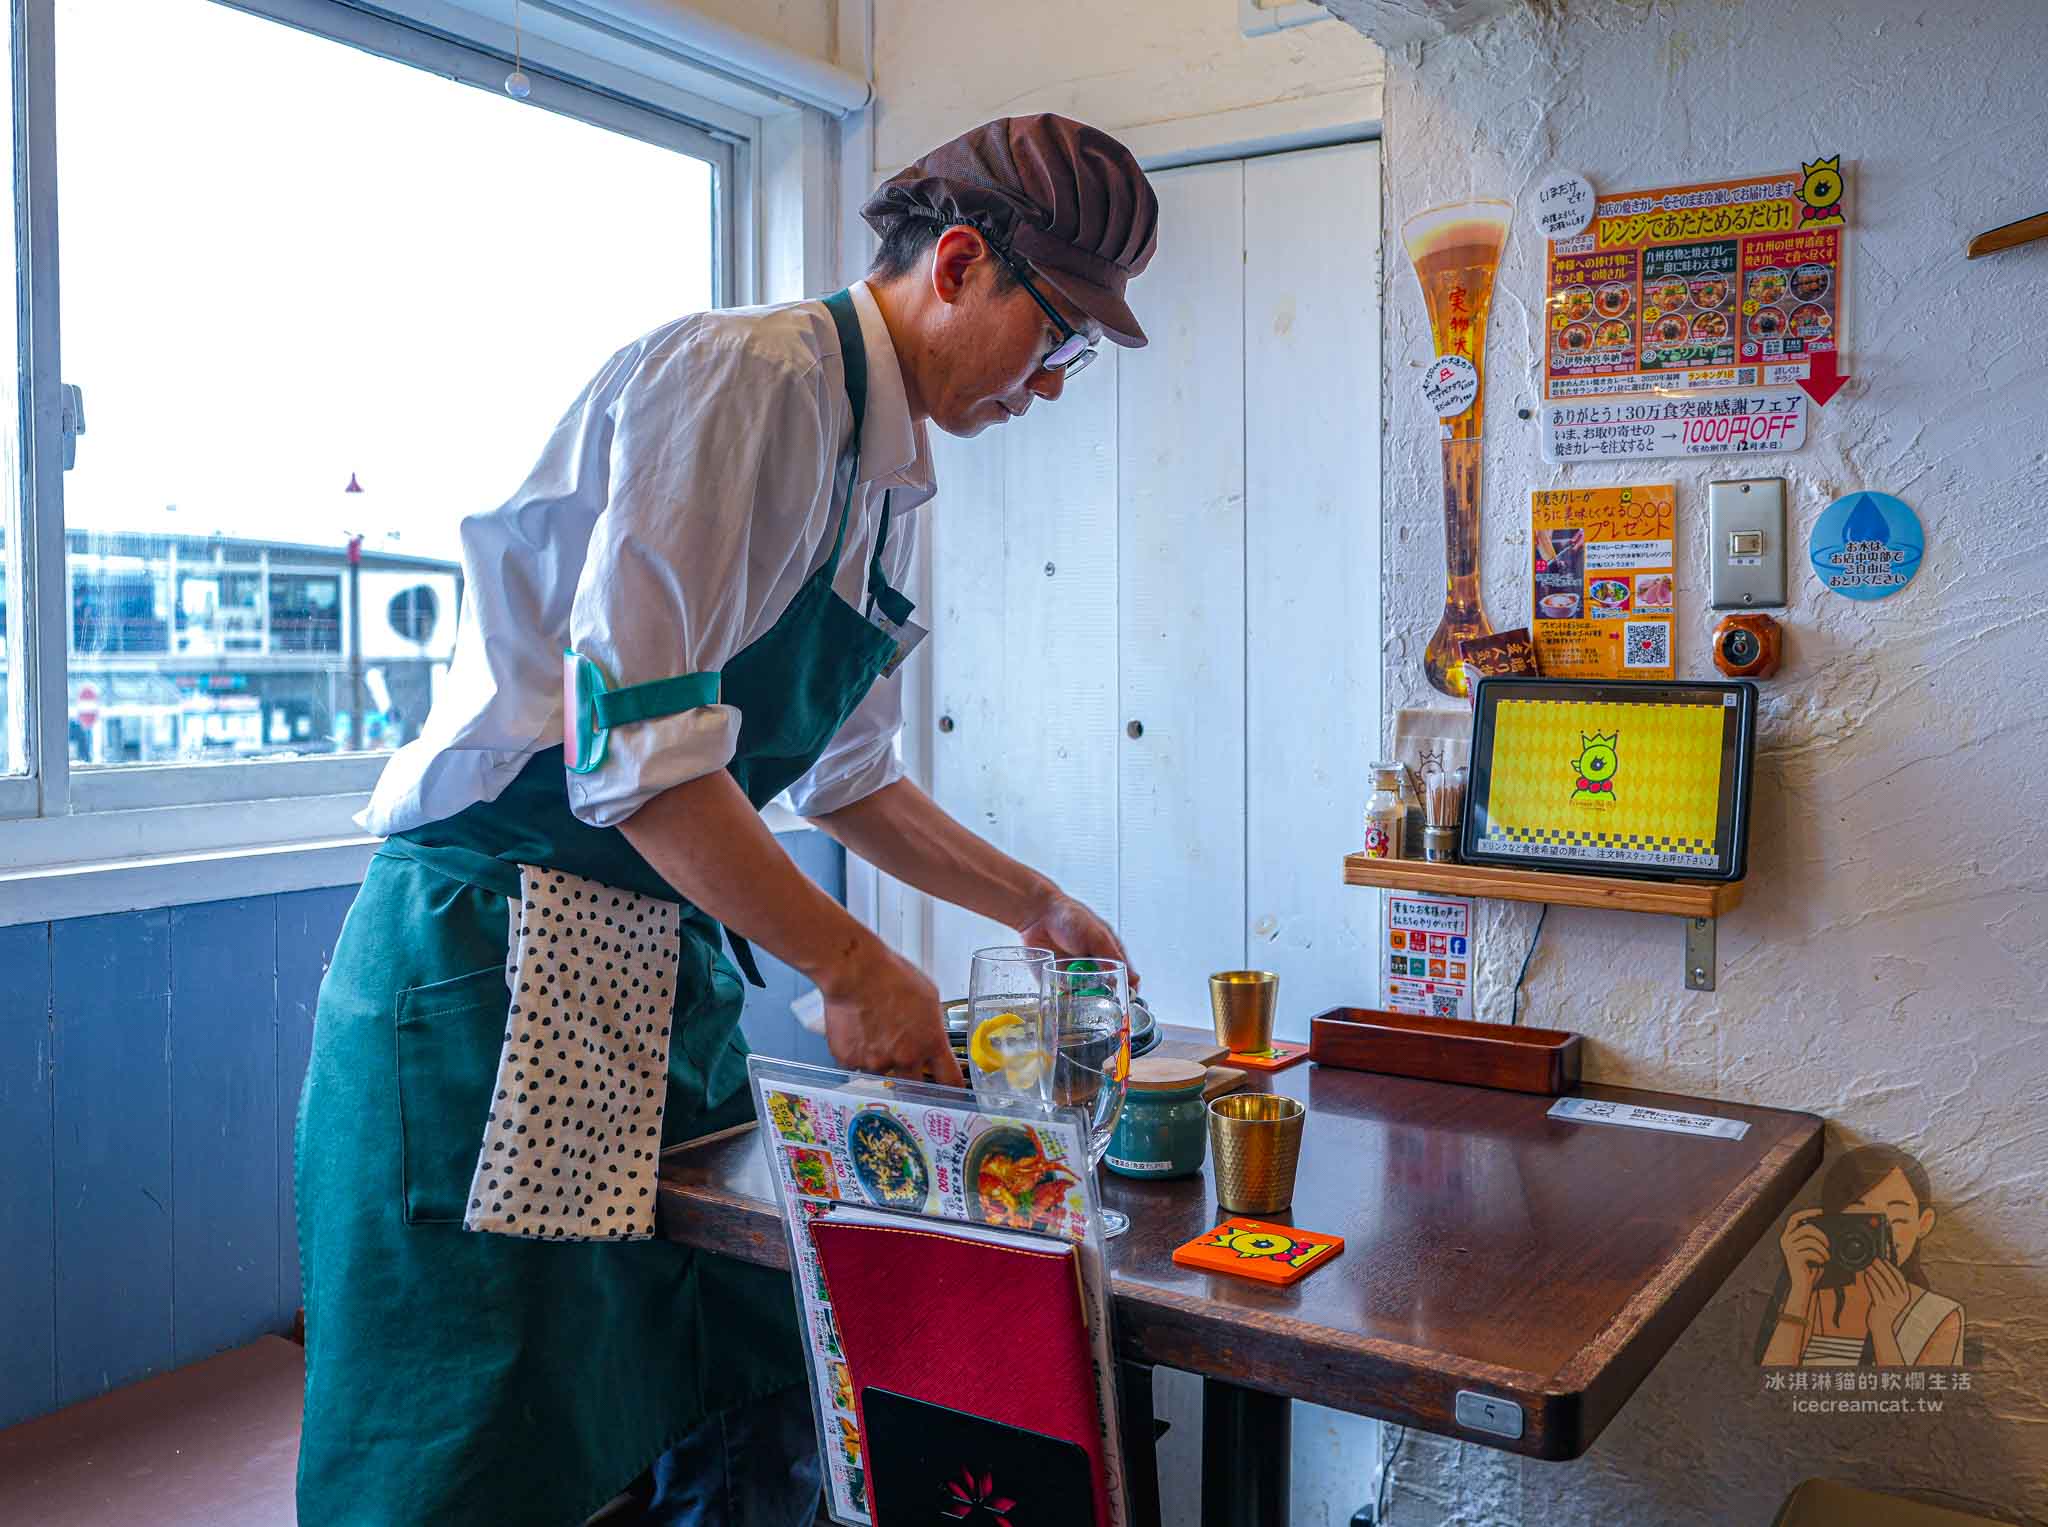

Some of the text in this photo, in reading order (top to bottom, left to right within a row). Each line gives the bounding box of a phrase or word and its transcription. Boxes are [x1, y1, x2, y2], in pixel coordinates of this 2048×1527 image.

[1539, 180, 1579, 203] いまだけ
[1601, 202, 1789, 243] レンジであたためるだけ!
[1554, 425, 1655, 441] いま、お取り寄せの
[1682, 414, 1798, 444] 1000円OFF
[1554, 440, 1655, 456] 焼きカレーを注文すると
[1831, 551, 1903, 564] お店中央部で
[1845, 564, 1890, 575] ご自由に
[1830, 574, 1907, 587] おとりください
[780, 1103, 793, 1127] SOLD
